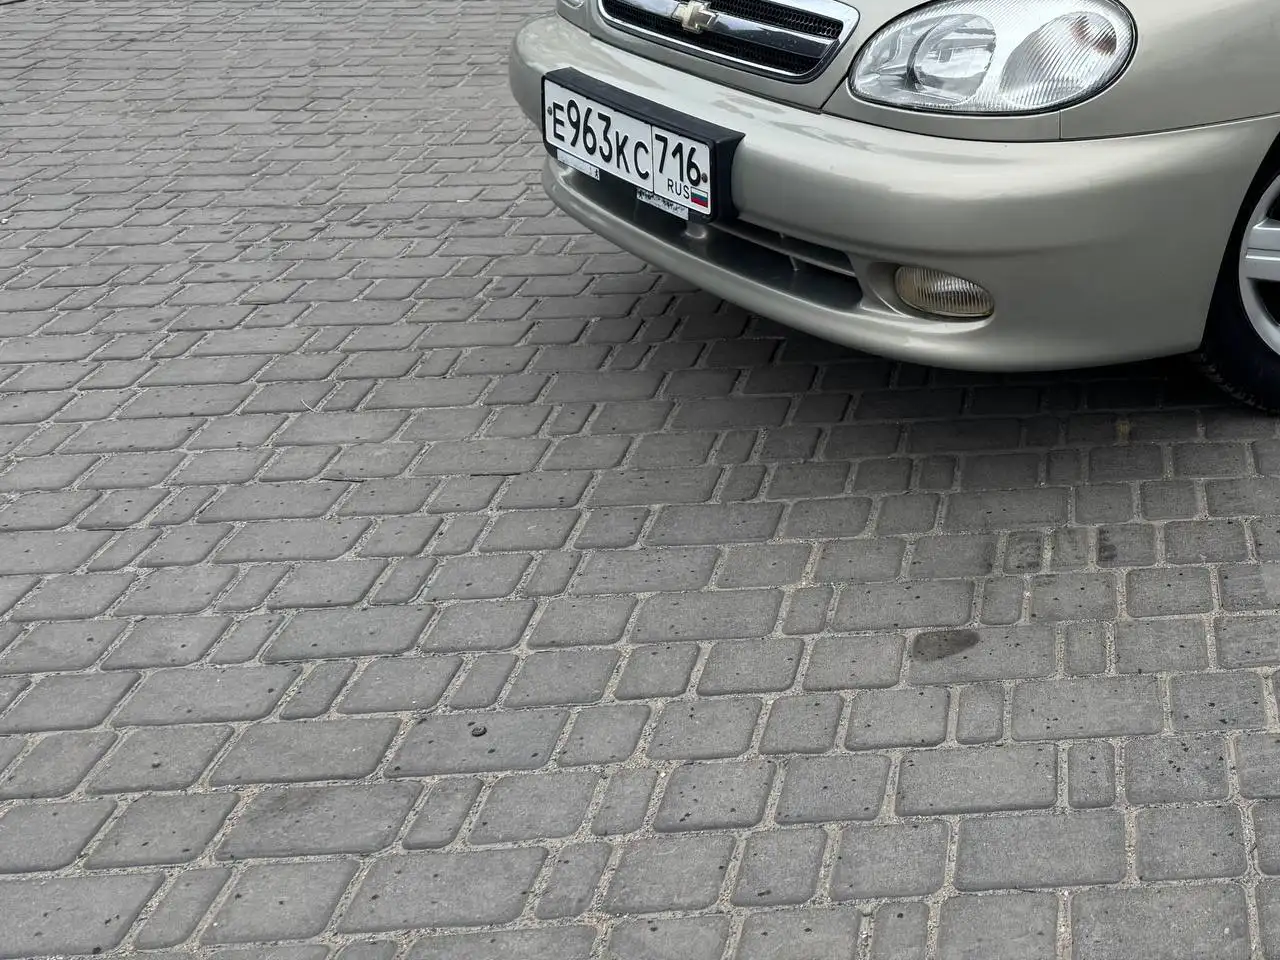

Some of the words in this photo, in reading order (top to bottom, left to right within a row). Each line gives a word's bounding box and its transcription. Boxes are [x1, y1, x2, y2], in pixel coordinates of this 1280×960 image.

[552, 99, 650, 181] E963KC
[654, 133, 701, 187] 716
[667, 178, 690, 200] RUS
